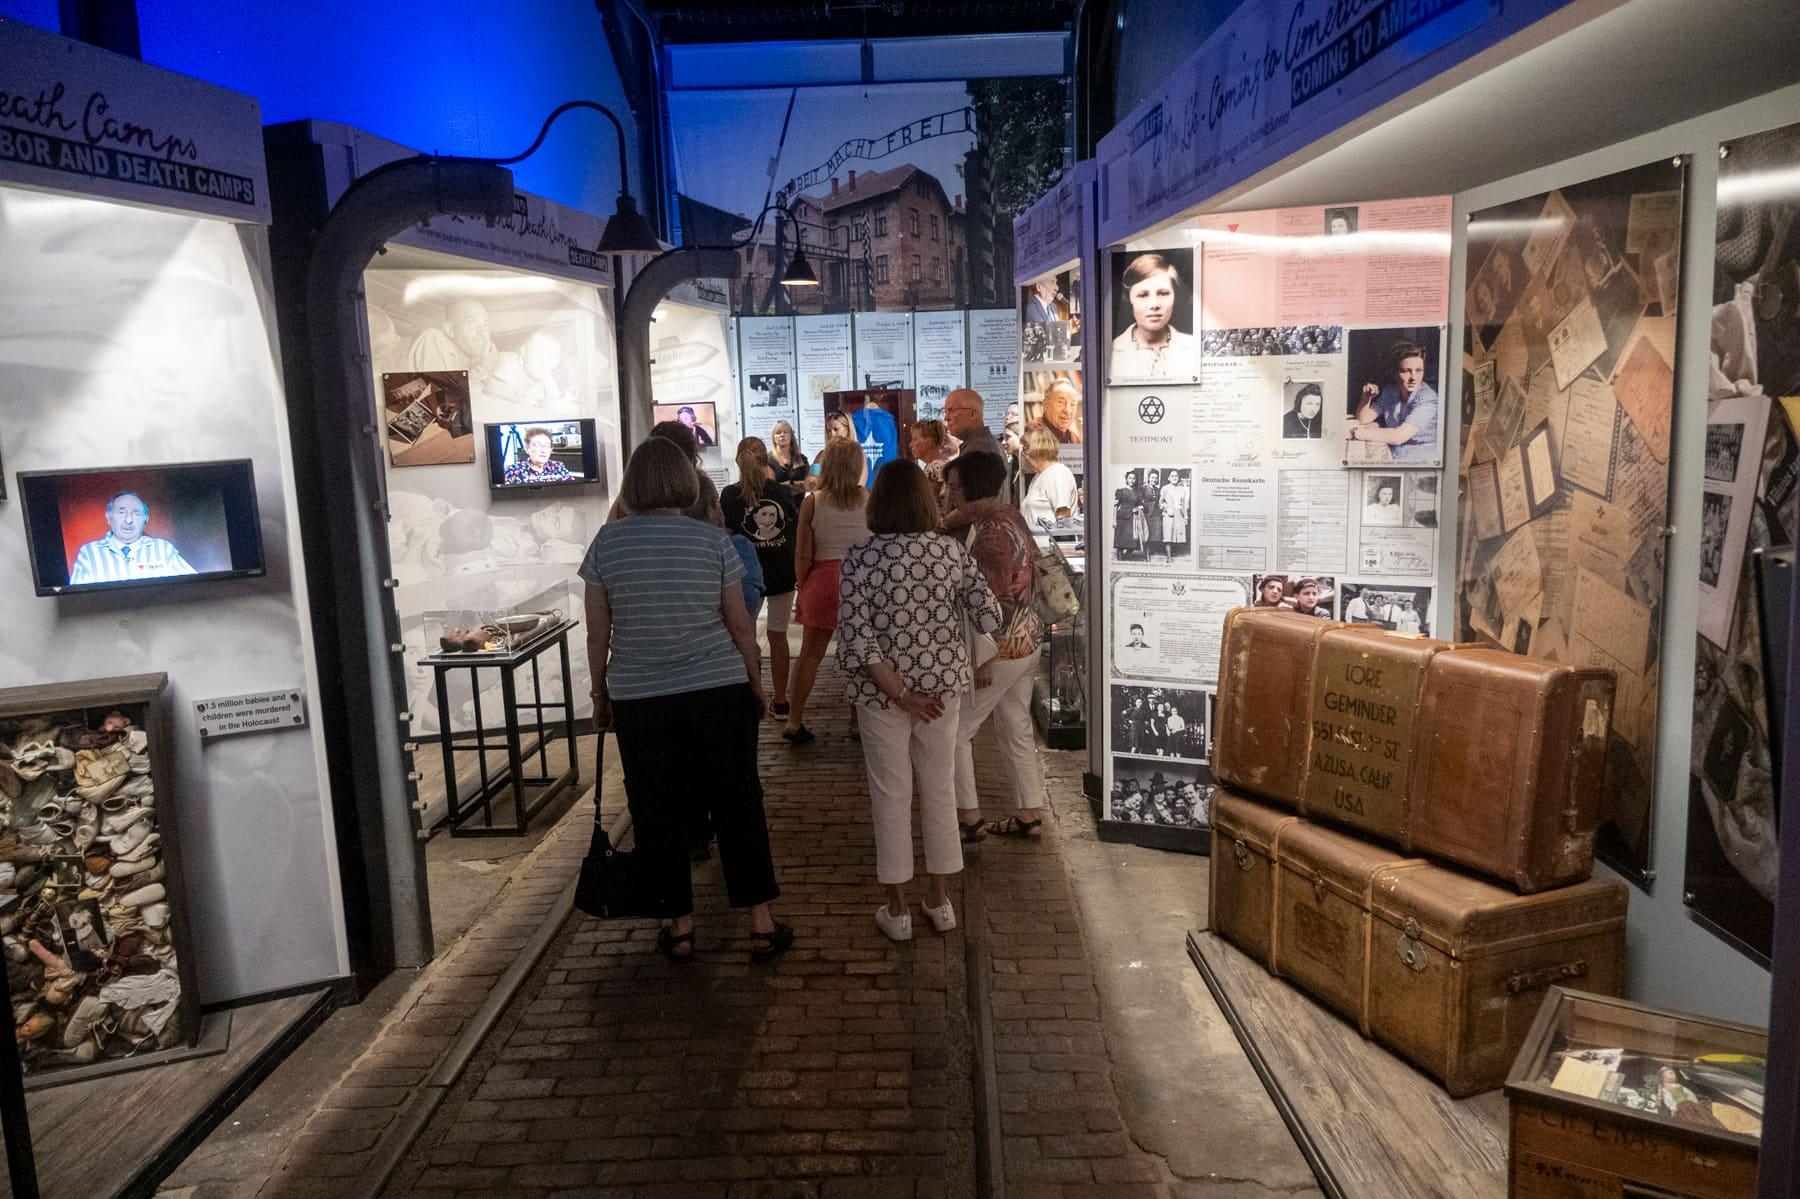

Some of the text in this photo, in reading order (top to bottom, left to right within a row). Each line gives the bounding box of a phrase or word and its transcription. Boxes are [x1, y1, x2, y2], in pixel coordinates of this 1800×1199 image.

[1209, 54, 1262, 131] Coming
[1264, 40, 1281, 80] to
[1285, 0, 1372, 71] Americ
[1293, 40, 1350, 101] COMING
[1353, 21, 1373, 62] TO
[0, 82, 197, 161] eath Camps
[826, 138, 876, 178] MACHT
[886, 112, 944, 155] FREI
[0, 130, 254, 203] BOR AND DEATH CAMPS
[519, 214, 549, 239] Death
[549, 217, 578, 248] Camps
[1129, 435, 1173, 444] TESTIMONY
[1345, 663, 1382, 689] LORE
[202, 703, 291, 722] children were murdered
[205, 693, 286, 710] 1.5 million babies and
[1324, 691, 1397, 727] GEMINDER
[219, 716, 280, 731] in the Holocaust
[1313, 719, 1333, 742] 651
[1384, 739, 1401, 762] ST.
[1334, 787, 1364, 817] USA
